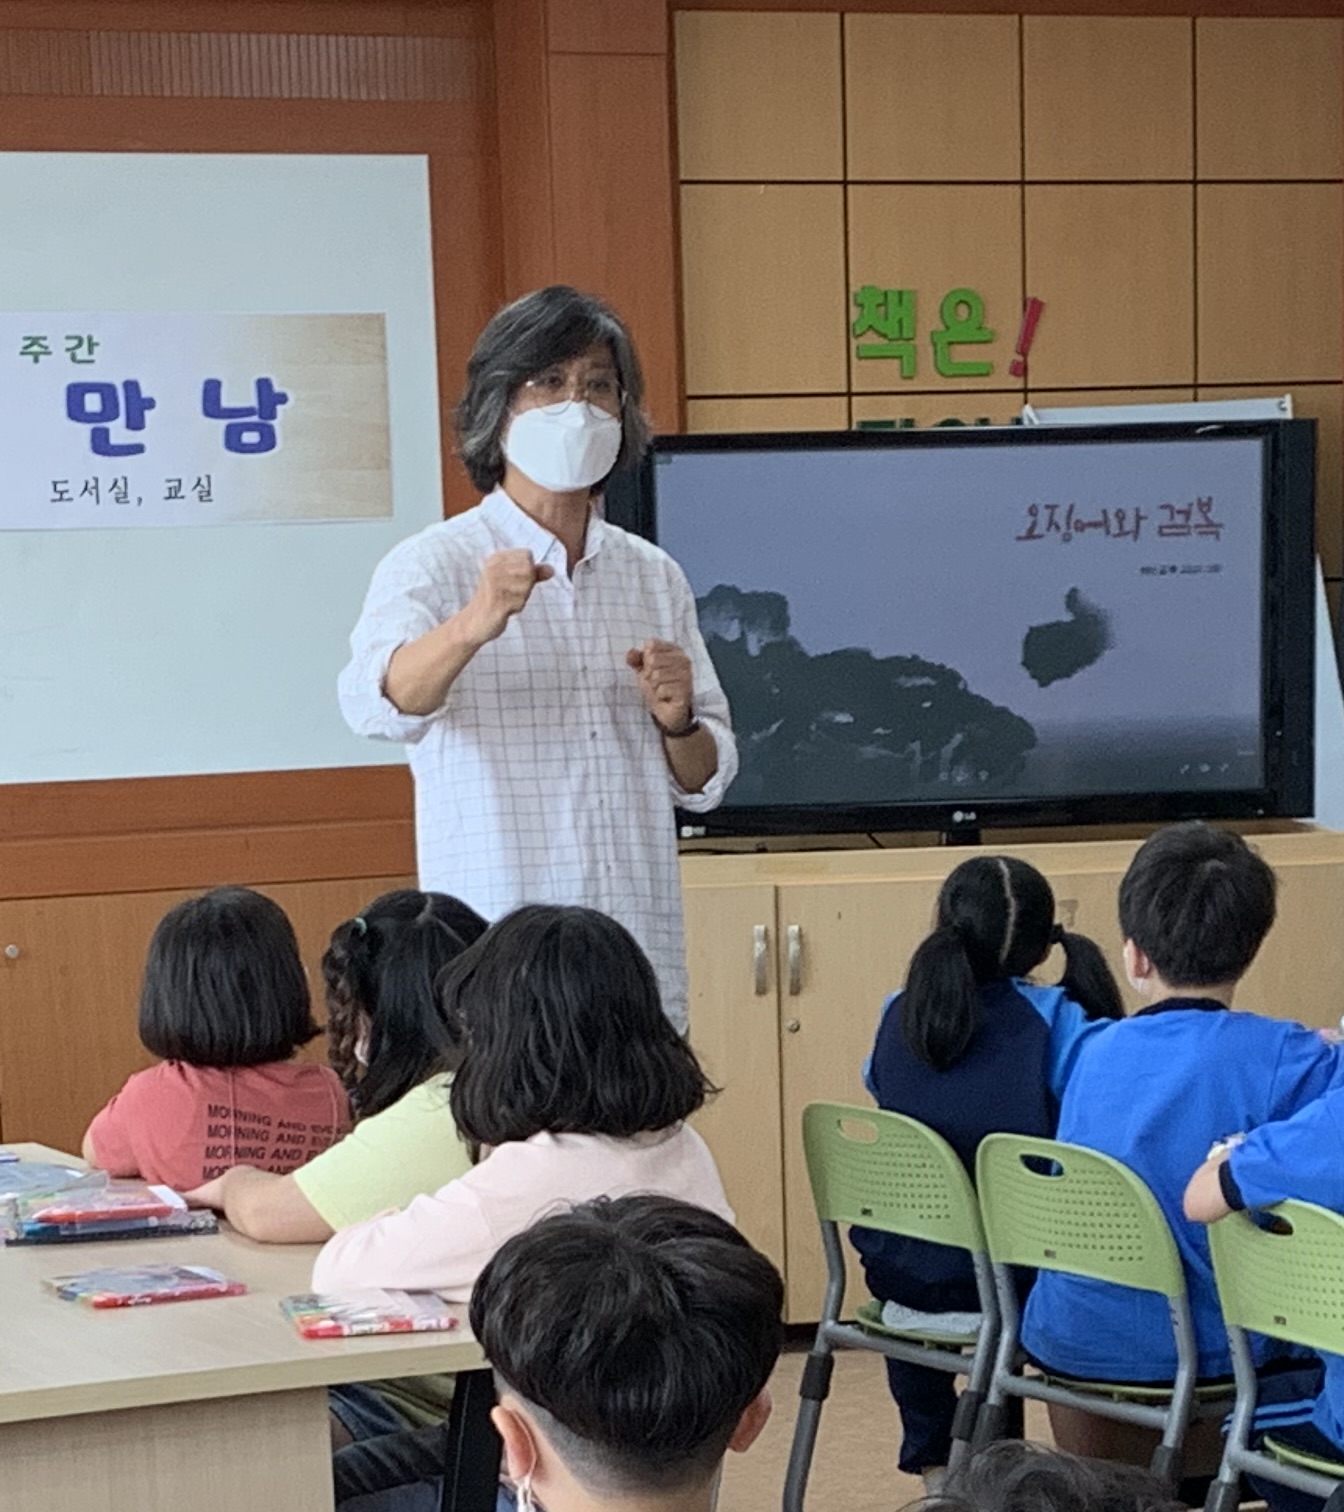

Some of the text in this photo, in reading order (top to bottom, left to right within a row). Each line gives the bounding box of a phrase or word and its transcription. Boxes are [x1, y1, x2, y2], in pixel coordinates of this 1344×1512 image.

[853, 285, 1045, 379] 책은!
[19, 334, 101, 365] 주간
[66, 378, 289, 457] 만남
[50, 475, 142, 506] 도서실,
[163, 474, 214, 503] 교실
[207, 1103, 272, 1127] MORNING
[277, 1119, 307, 1132] AND
[207, 1124, 270, 1142] MORNING
[276, 1132, 306, 1145] AND
[205, 1144, 266, 1161] MORNING
[270, 1147, 303, 1161] AND
